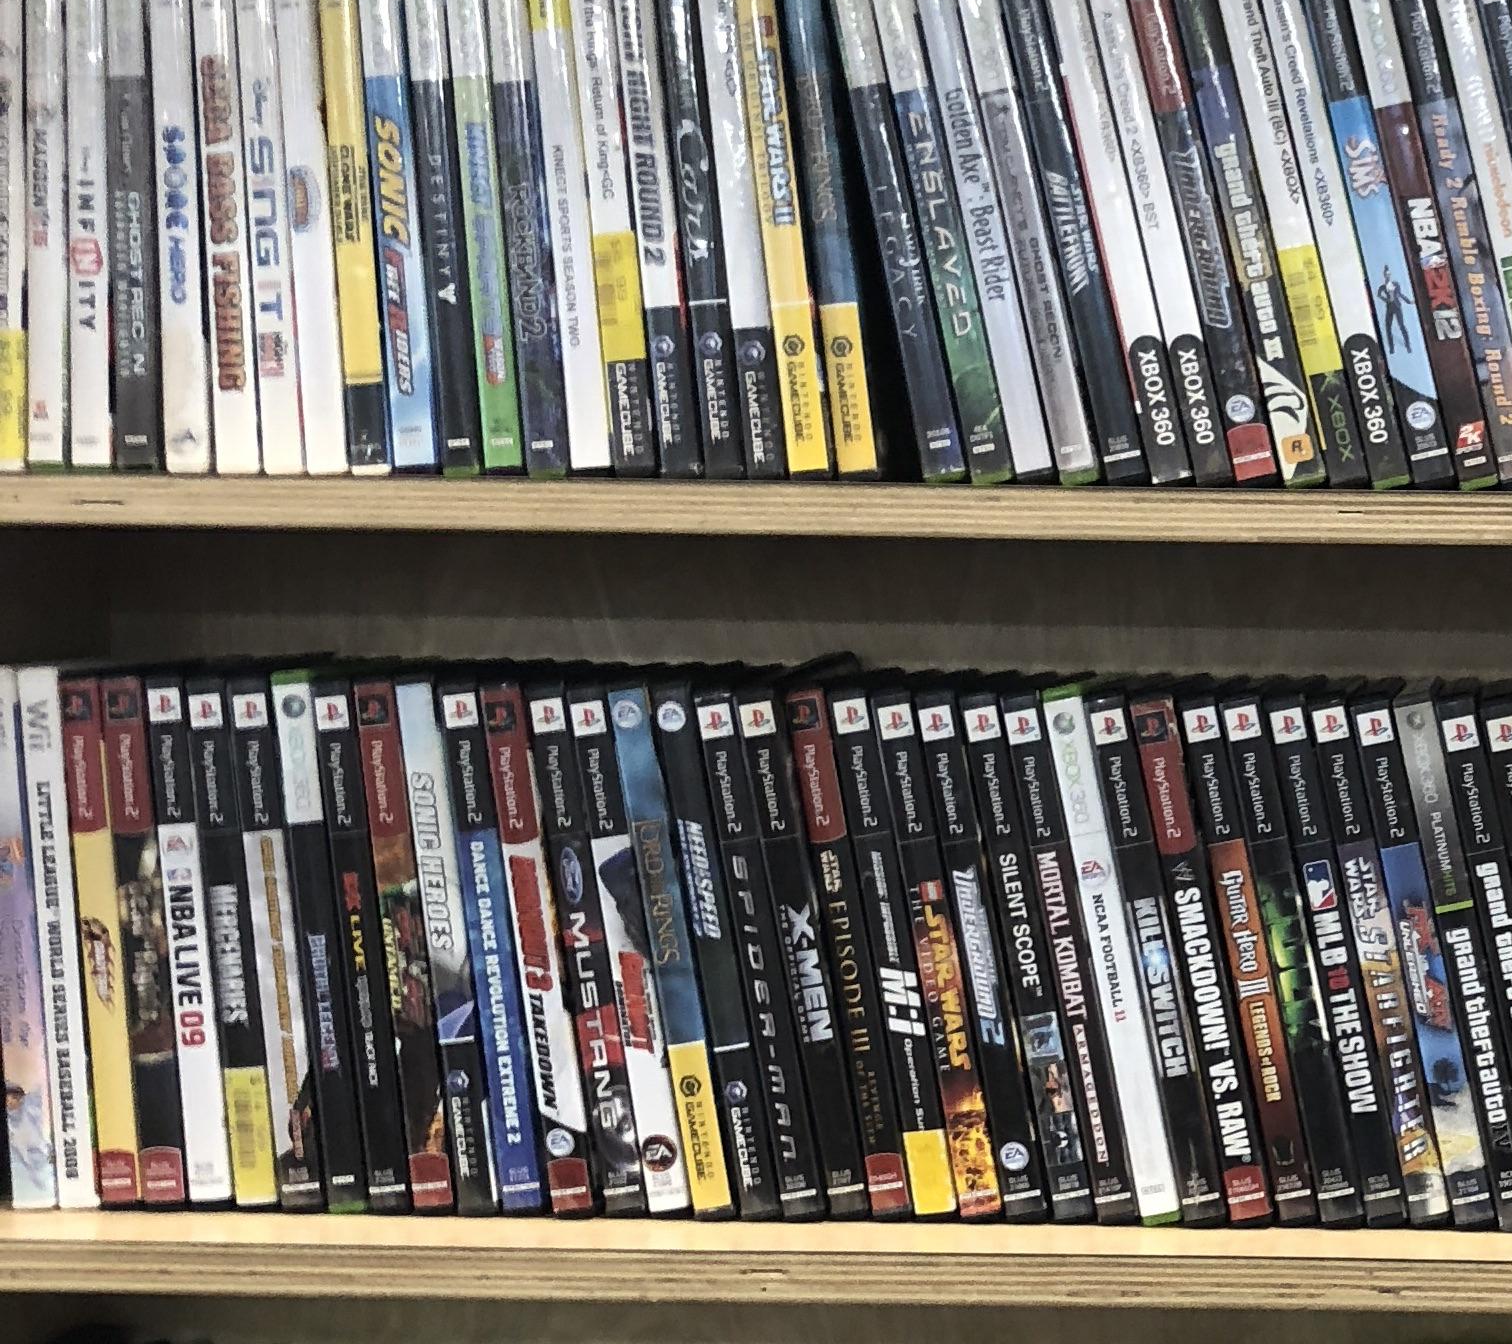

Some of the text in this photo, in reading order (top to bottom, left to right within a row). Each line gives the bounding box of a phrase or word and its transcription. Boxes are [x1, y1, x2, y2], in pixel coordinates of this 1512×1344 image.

[1407, 197, 1440, 256] NBA
[1178, 349, 1215, 445] XBOX 360
[170, 884, 202, 1047] NBA LIVE 09
[789, 903, 832, 1042] X-MEN
[999, 853, 1039, 986] SILENT SCOPE
[1036, 851, 1108, 1163] MORTAL KOMBAT ARMAGEDDON
[1175, 887, 1251, 1157] SMACKDOWN! VS. RAW
